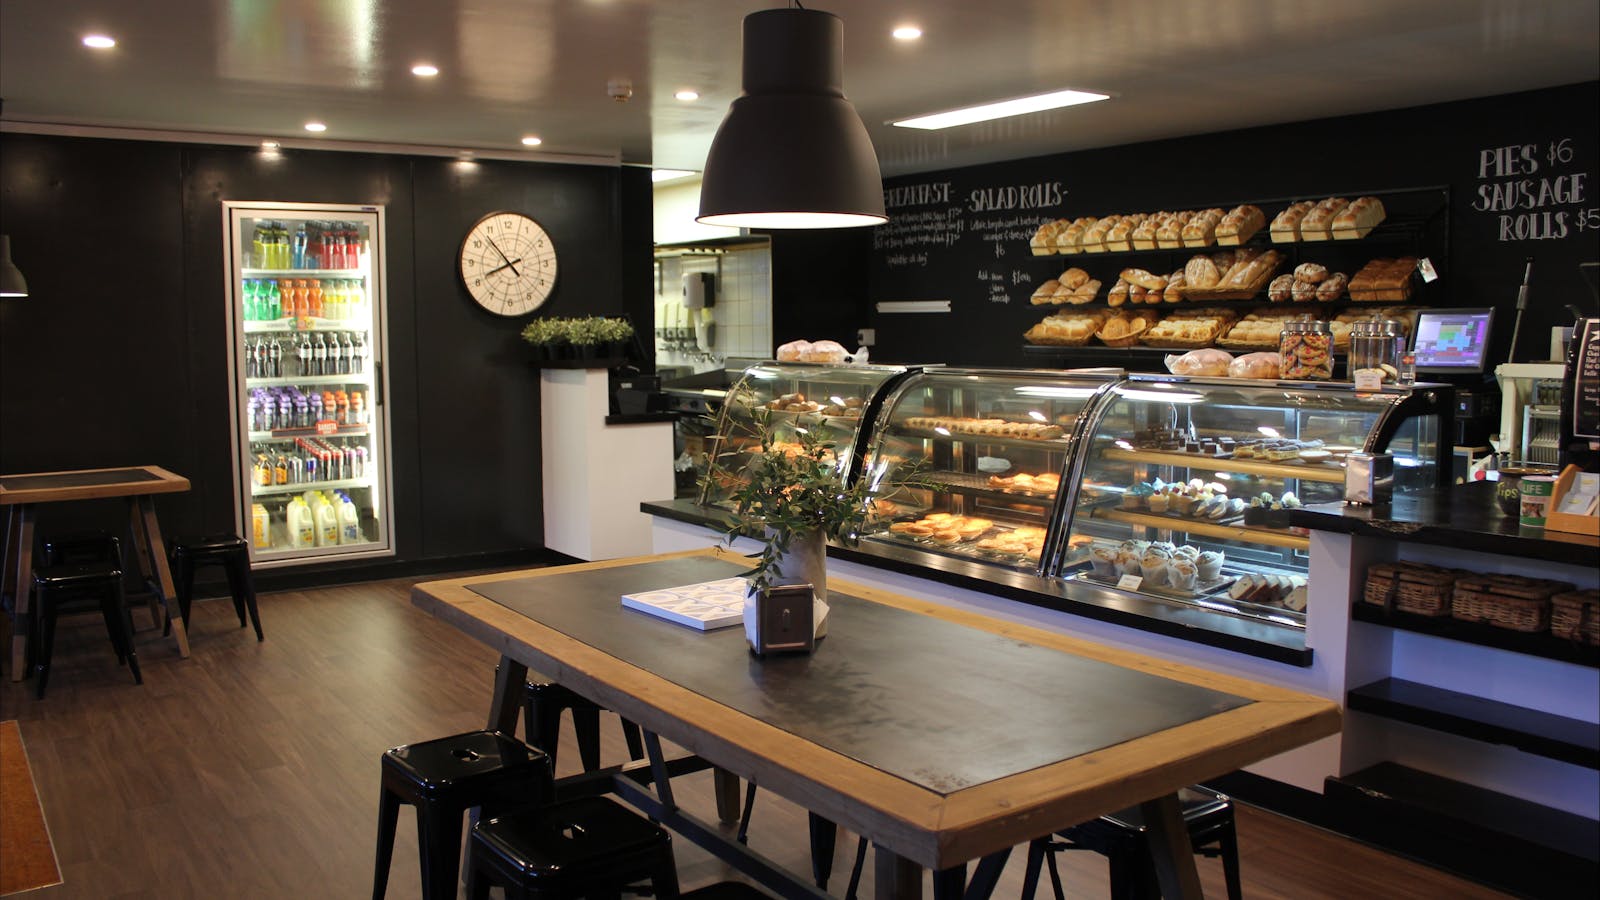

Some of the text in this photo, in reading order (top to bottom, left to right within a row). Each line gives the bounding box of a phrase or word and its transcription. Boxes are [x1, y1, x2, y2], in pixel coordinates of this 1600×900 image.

[1478, 138, 1573, 178] PIES $6
[1472, 173, 1587, 212] SAUSAGE
[504, 221, 512, 230] 12
[1499, 211, 1569, 241] ROLLS
[537, 240, 543, 248] 2
[1496, 481, 1519, 500] Tips
